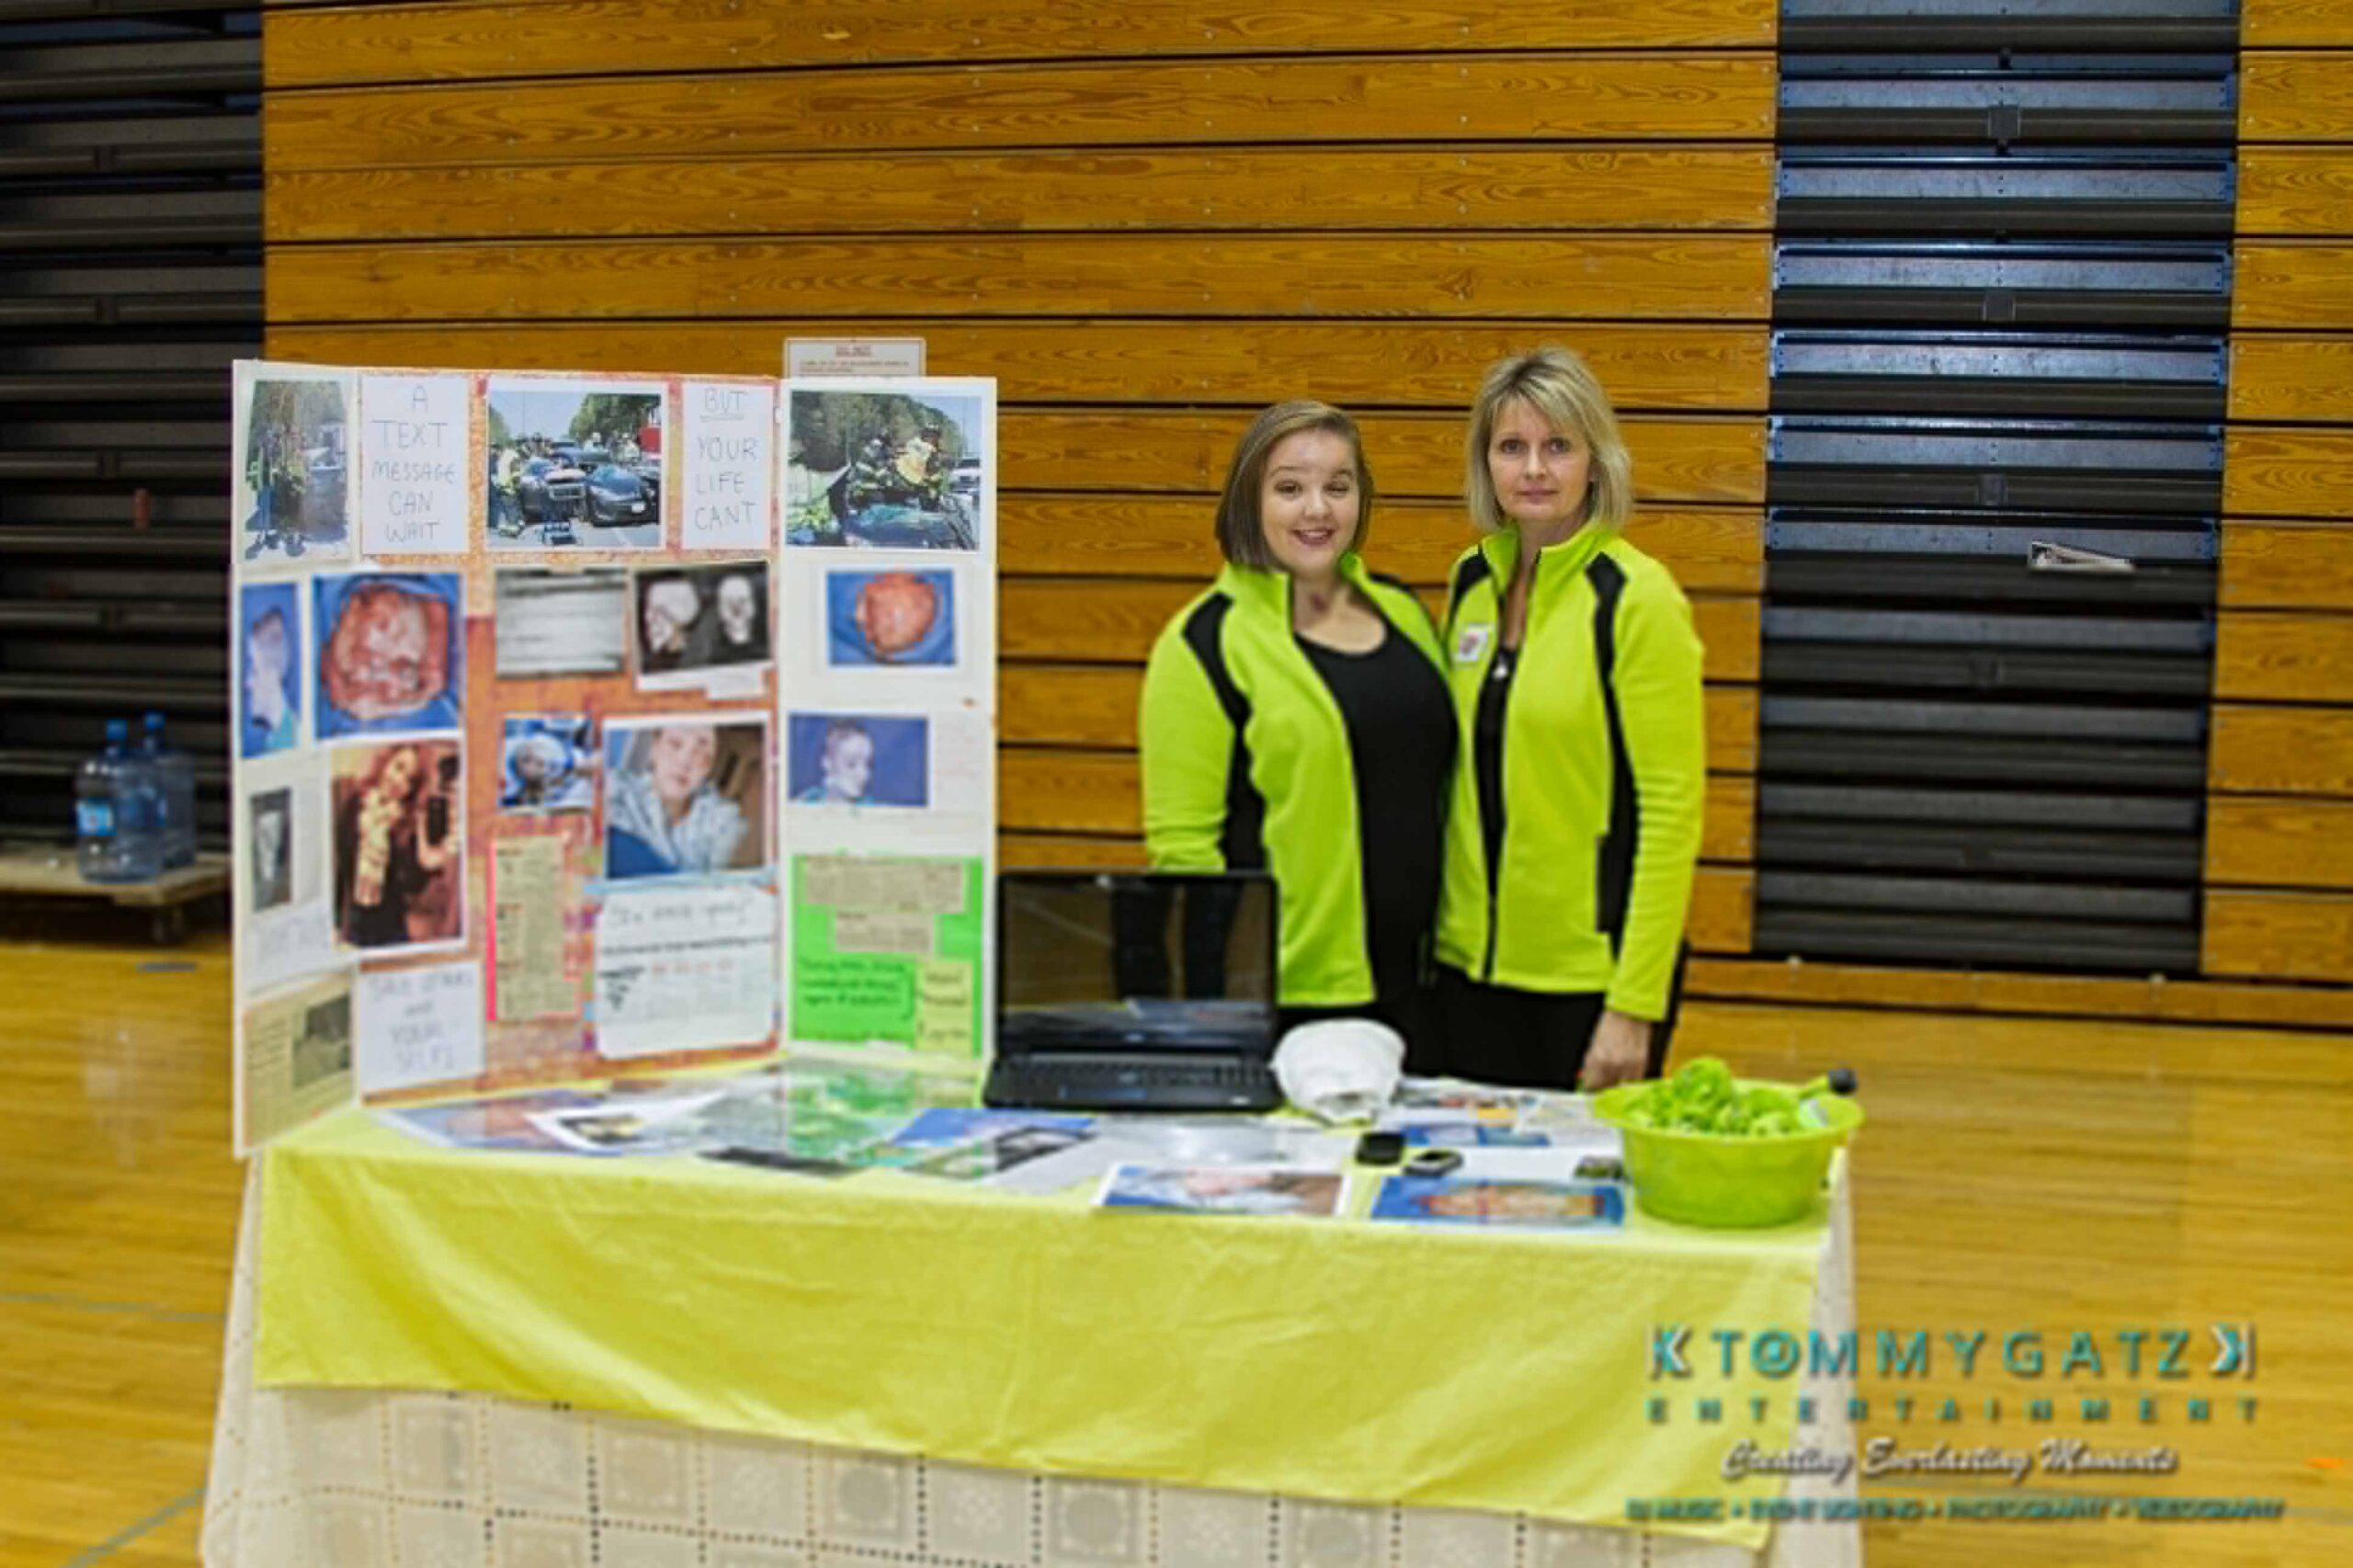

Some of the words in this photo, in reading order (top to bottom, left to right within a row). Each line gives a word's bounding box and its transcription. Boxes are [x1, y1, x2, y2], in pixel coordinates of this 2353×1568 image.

[412, 384, 428, 413] A
[703, 387, 749, 413] BUT
[371, 420, 449, 449] TEXT
[697, 436, 758, 462] YOUR
[371, 461, 456, 484] MESSAGE
[694, 472, 745, 495] LIFE
[388, 491, 434, 517] CAN
[694, 503, 757, 530] CANT
[384, 521, 440, 543] WAIT
